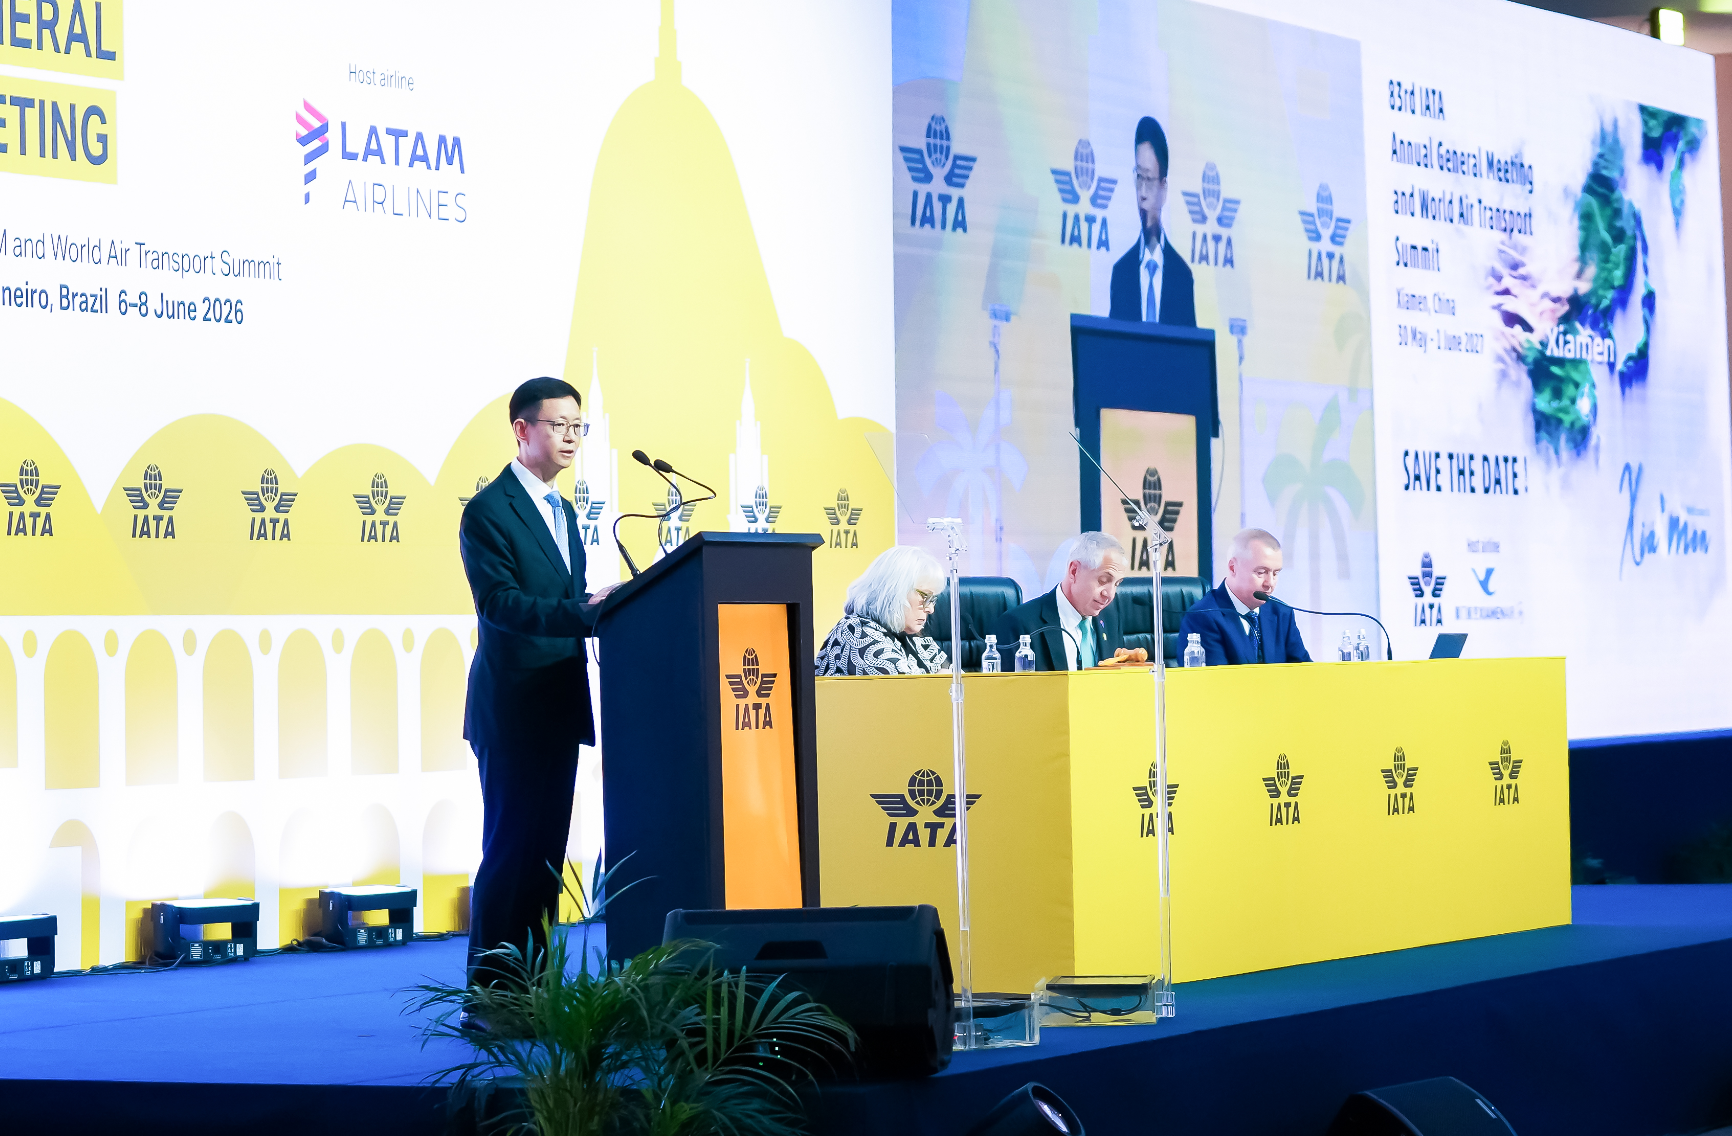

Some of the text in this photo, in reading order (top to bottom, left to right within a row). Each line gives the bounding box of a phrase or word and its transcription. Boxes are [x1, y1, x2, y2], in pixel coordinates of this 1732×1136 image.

[0, 0, 116, 61] ERAL
[349, 63, 414, 91] Host airline
[1389, 79, 1445, 121] 83rd IATA
[341, 121, 465, 174] LATAM
[1391, 131, 1534, 194] Annual General Meeting
[343, 180, 467, 223] AIRLINES
[911, 190, 968, 233] IATA
[1394, 184, 1533, 240] and World Air Transport
[1060, 210, 1110, 252] IATA
[13, 233, 45, 260] and
[51, 233, 101, 264] World
[107, 240, 130, 266] Air
[135, 242, 216, 279] Transport
[220, 250, 282, 281] Summit
[1191, 231, 1235, 269] IATA
[1307, 249, 1347, 285] IATA
[1395, 236, 1440, 272] Summit
[2, 281, 53, 313] neiro,
[60, 284, 108, 314] Brazil
[154, 292, 197, 321] June
[203, 296, 244, 325] 2026
[1545, 324, 1615, 363] Xiamen
[1403, 450, 1442, 492] SAVE
[1448, 452, 1476, 494] THE
[7, 511, 54, 536] IATA
[131, 514, 176, 539] IATA
[249, 517, 291, 541] IATA
[360, 520, 400, 542] IATA
[829, 529, 859, 549] IATA
[1130, 537, 1176, 571] IAA
[1414, 602, 1443, 627] IATA
[735, 703, 773, 730] IATA
[1387, 792, 1415, 816] IATA
[1493, 783, 1520, 806] IATA
[1140, 811, 1175, 838] IAA
[1269, 801, 1301, 827] IATA
